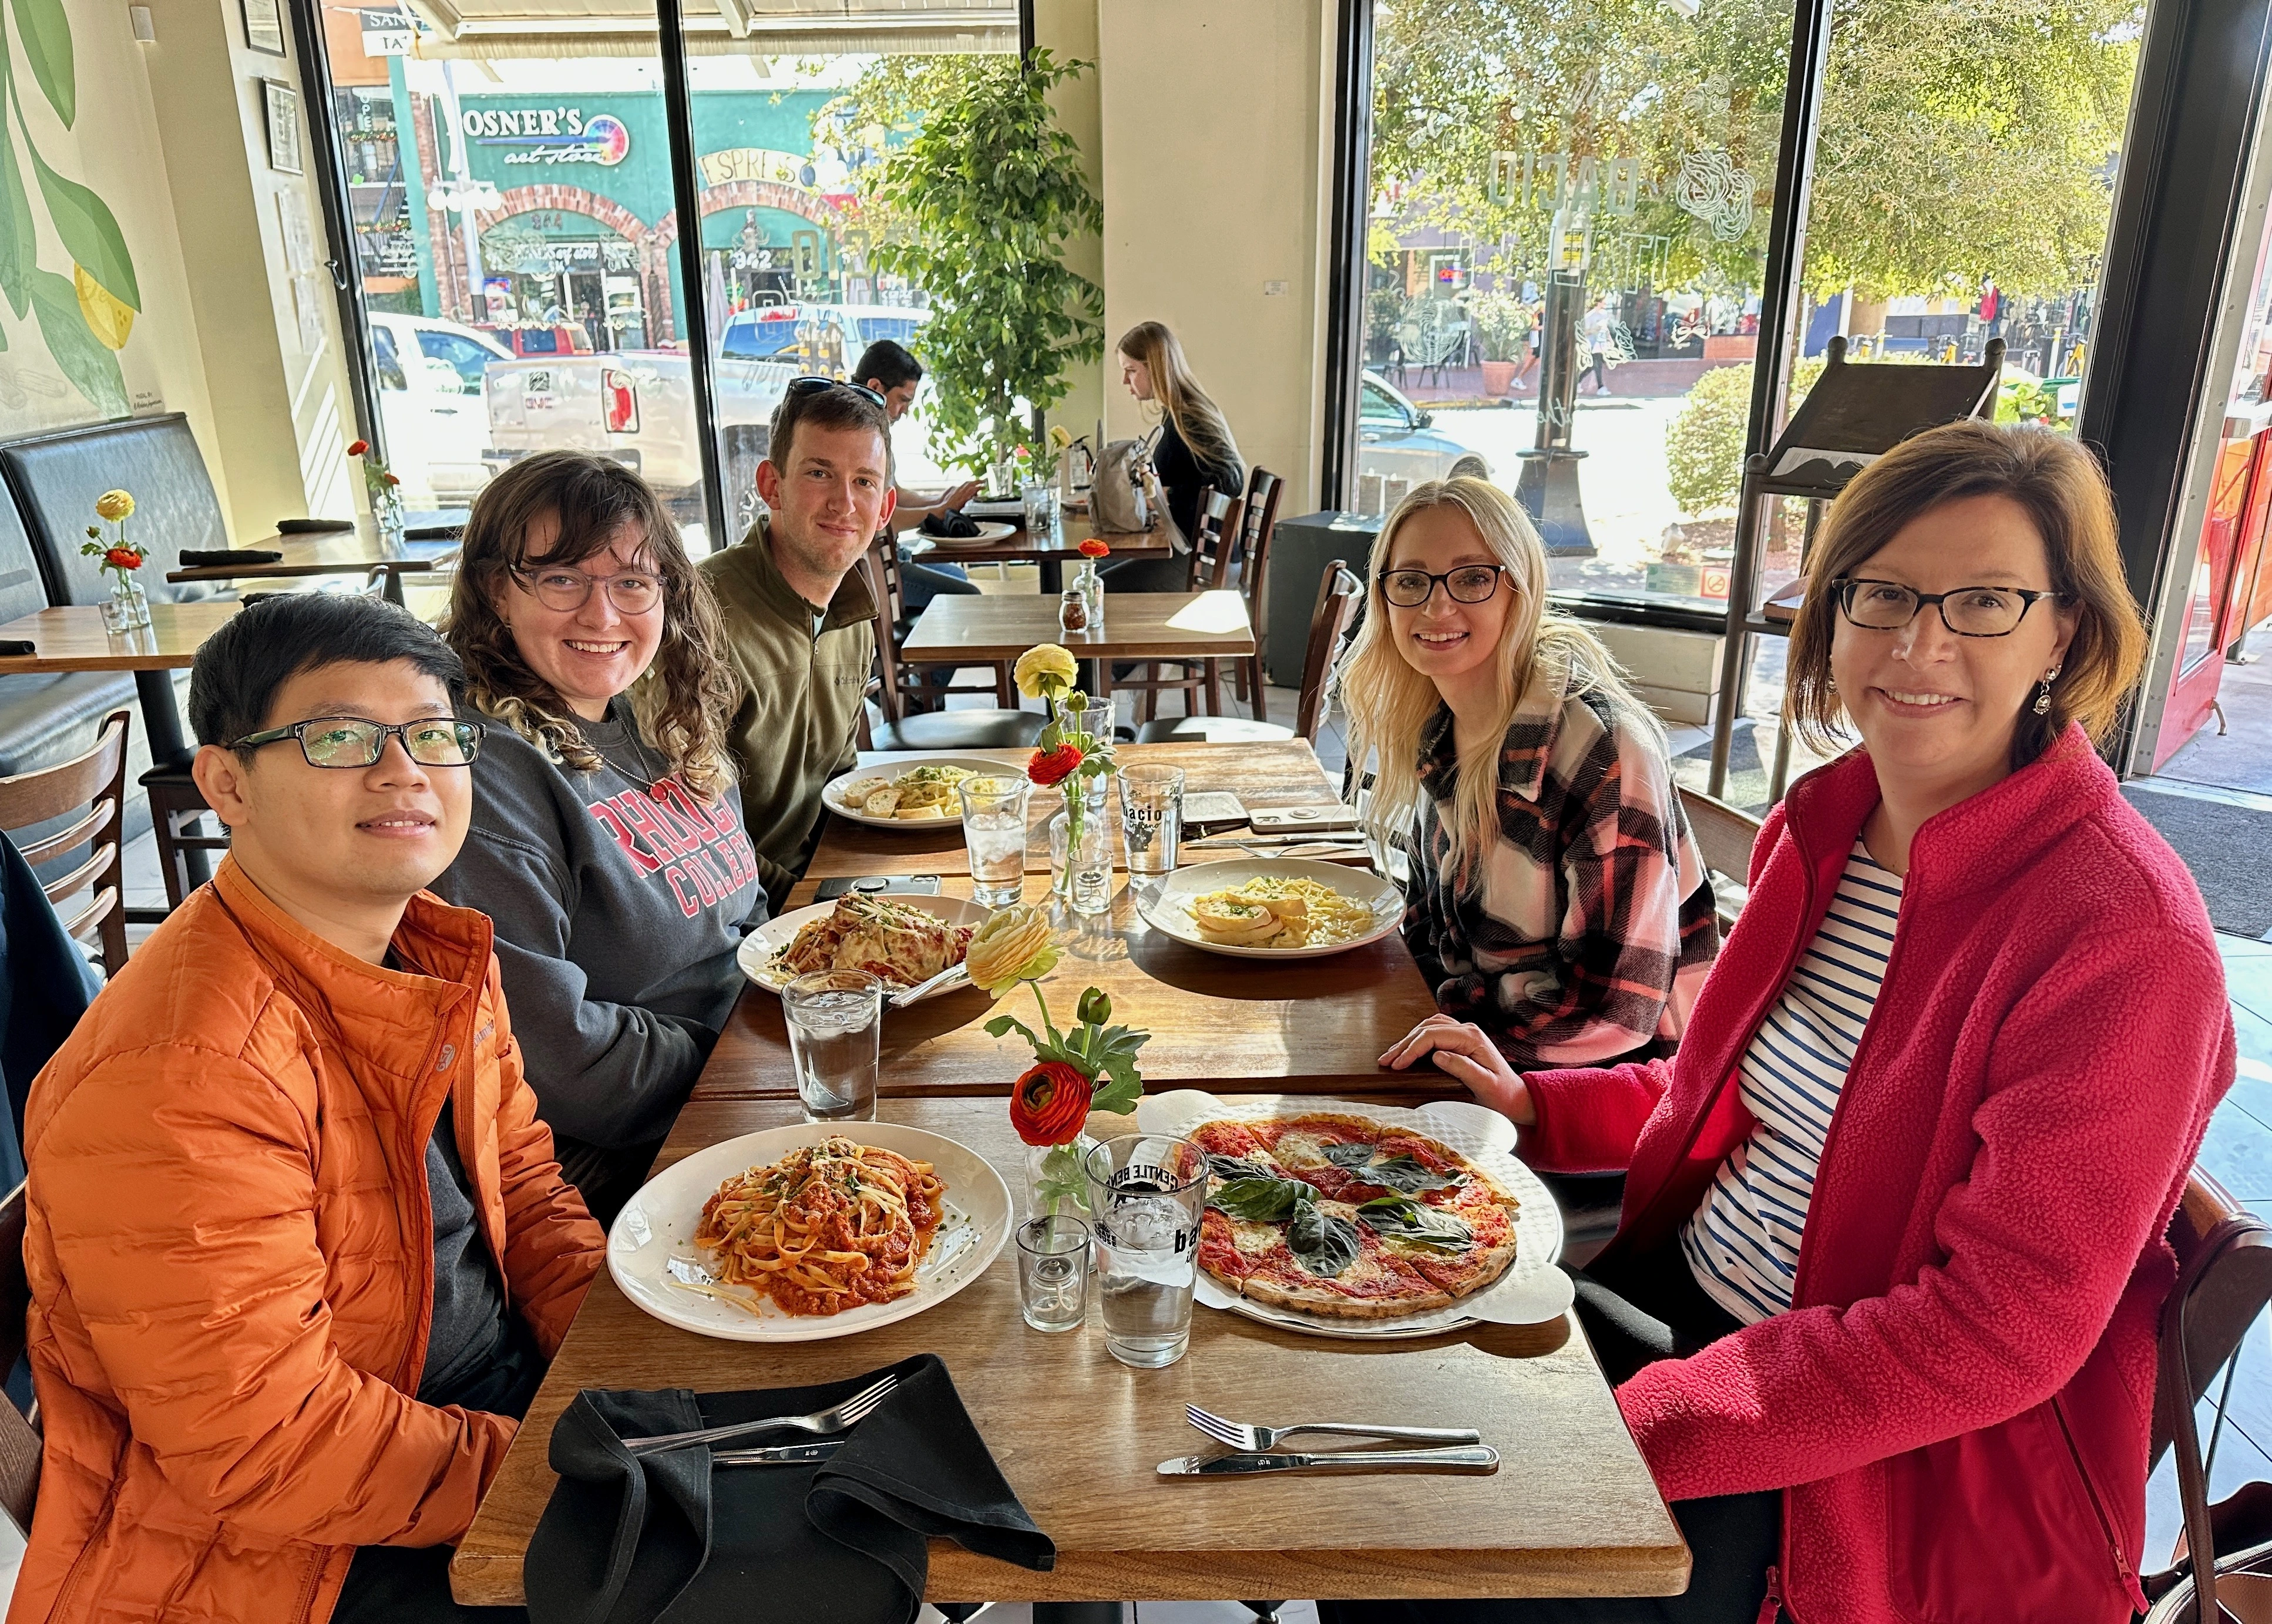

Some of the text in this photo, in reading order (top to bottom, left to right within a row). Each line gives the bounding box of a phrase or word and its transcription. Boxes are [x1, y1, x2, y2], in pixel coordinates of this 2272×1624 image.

[359, 93, 372, 132] OPE
[462, 106, 583, 136] OSNER'S
[504, 145, 545, 163] art
[526, 398, 553, 409] GMC
[1122, 802, 1162, 821] bacio
[587, 771, 739, 879] RHODE
